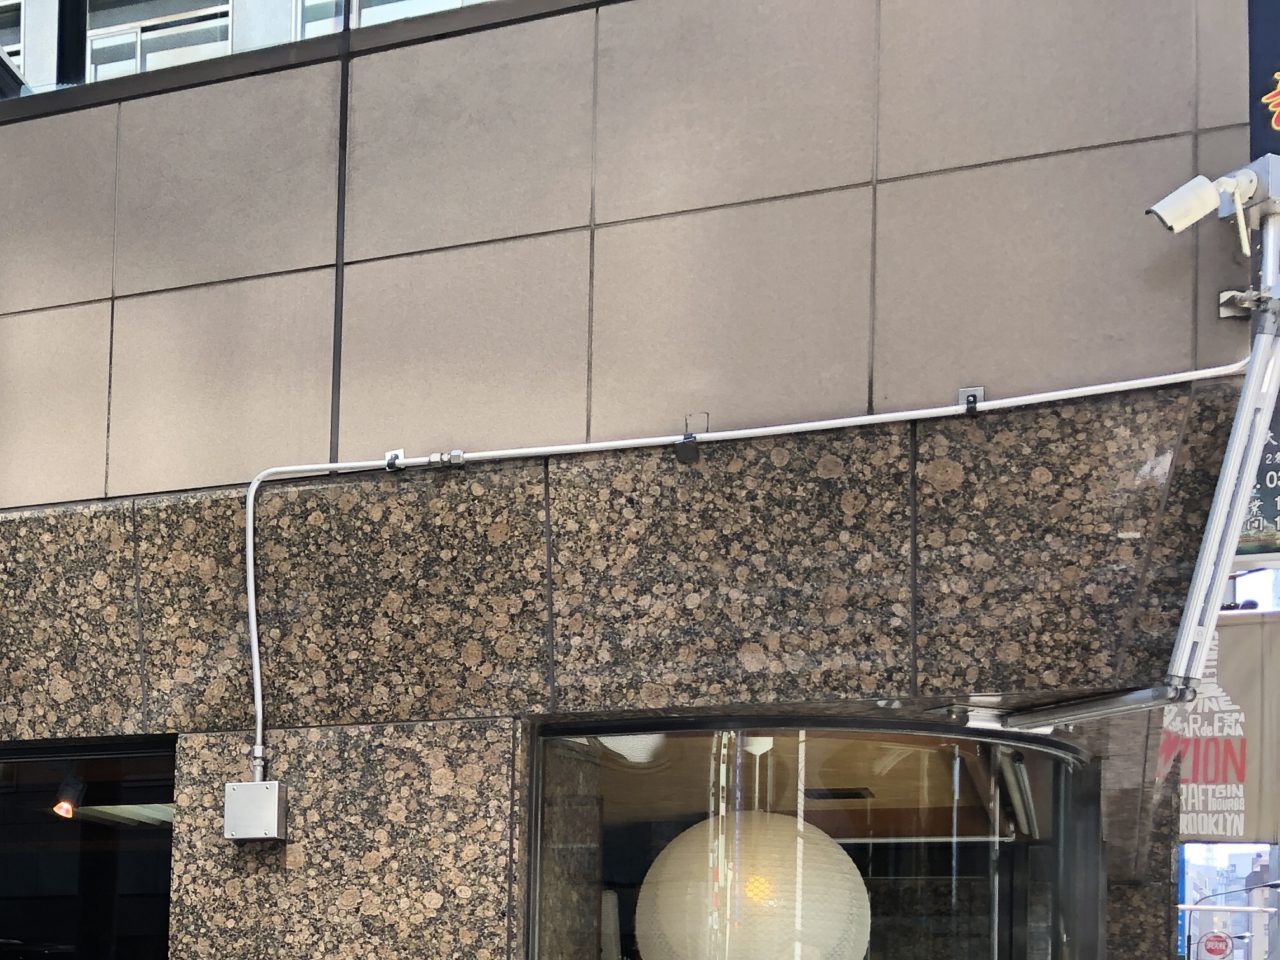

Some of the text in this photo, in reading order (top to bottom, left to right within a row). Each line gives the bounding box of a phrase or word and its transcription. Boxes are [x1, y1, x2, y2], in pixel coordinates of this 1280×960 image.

[1180, 783, 1244, 811] RAFT GIN
[1180, 812, 1245, 836] ROOKLYN
